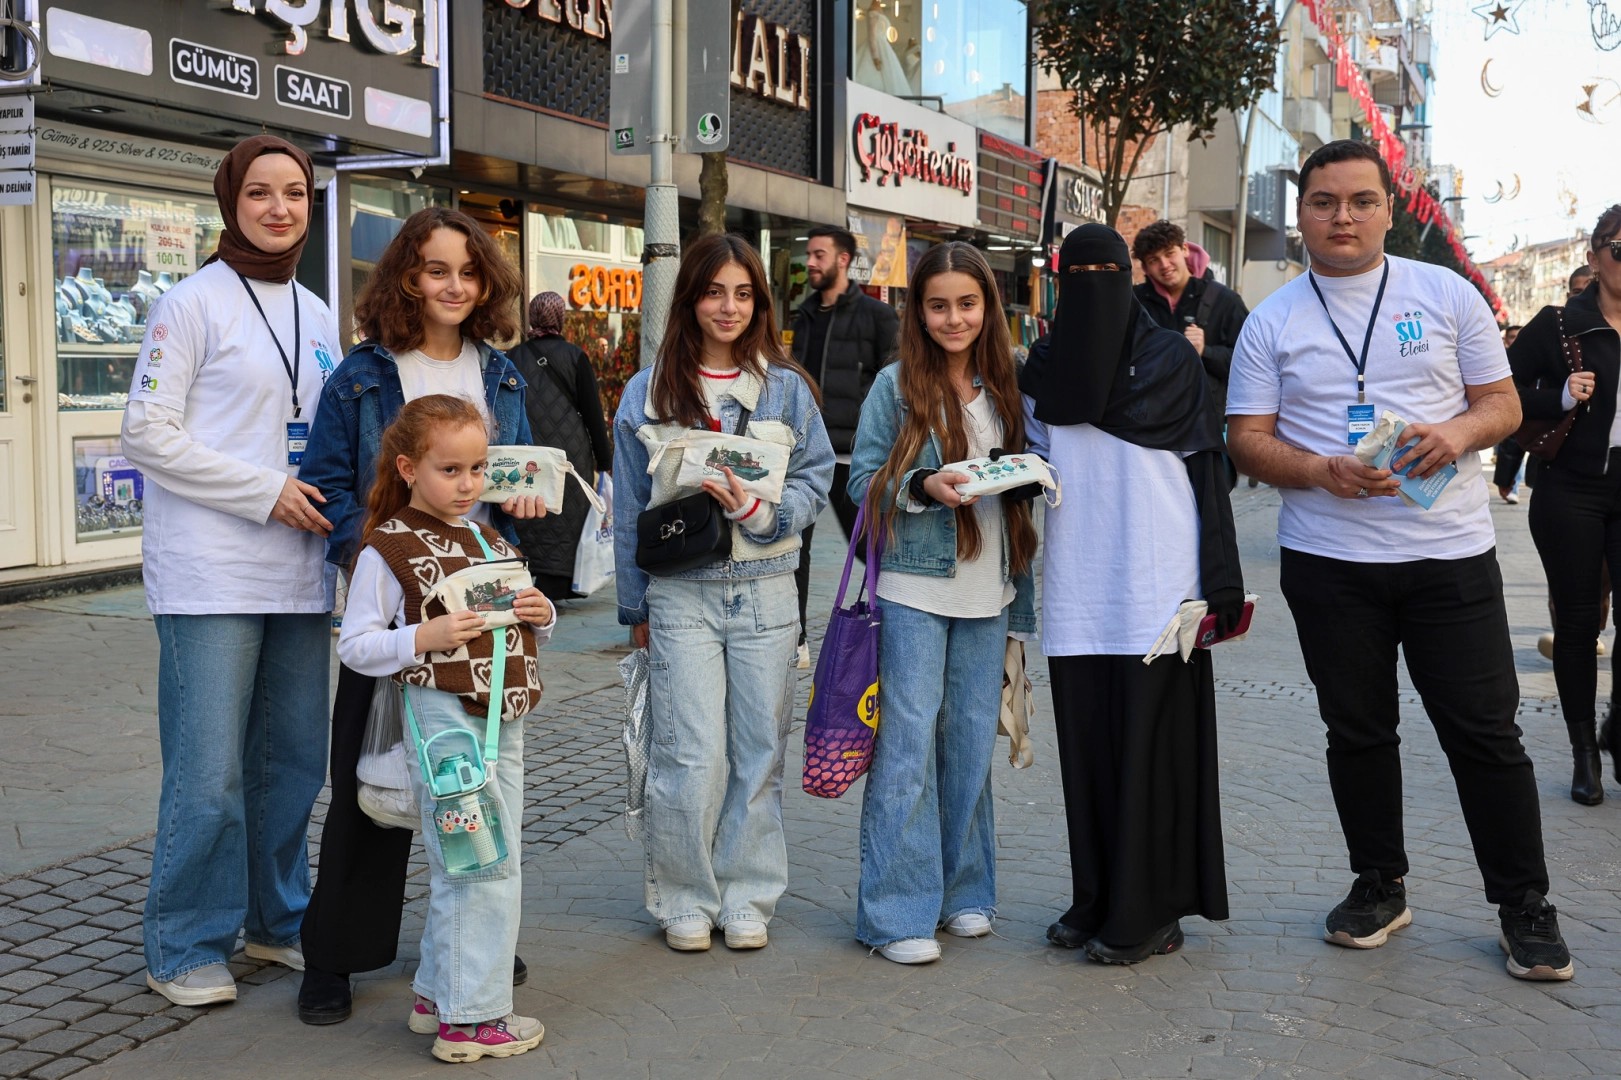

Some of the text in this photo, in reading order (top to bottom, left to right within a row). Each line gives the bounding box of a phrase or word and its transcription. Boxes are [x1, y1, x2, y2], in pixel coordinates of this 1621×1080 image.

[176, 47, 252, 93] GÜMÜŞ
[286, 74, 342, 110] SAAT
[8, 142, 31, 156] TAMİRİ
[41, 128, 78, 147] Gümüş
[78, 137, 91, 150] &
[92, 139, 118, 153] 925
[116, 142, 143, 157] Silver
[145, 146, 157, 158] &
[157, 147, 182, 162] 925
[181, 151, 211, 168] Gümüş
[6, 180, 32, 193] DELİNİR
[151, 223, 171, 233] KULAK
[158, 236, 185, 249] 200 TL
[156, 252, 188, 266] 100 TL
[1396, 320, 1423, 342] SU
[1399, 339, 1429, 358] Elçisi
[315, 349, 334, 371] SU
